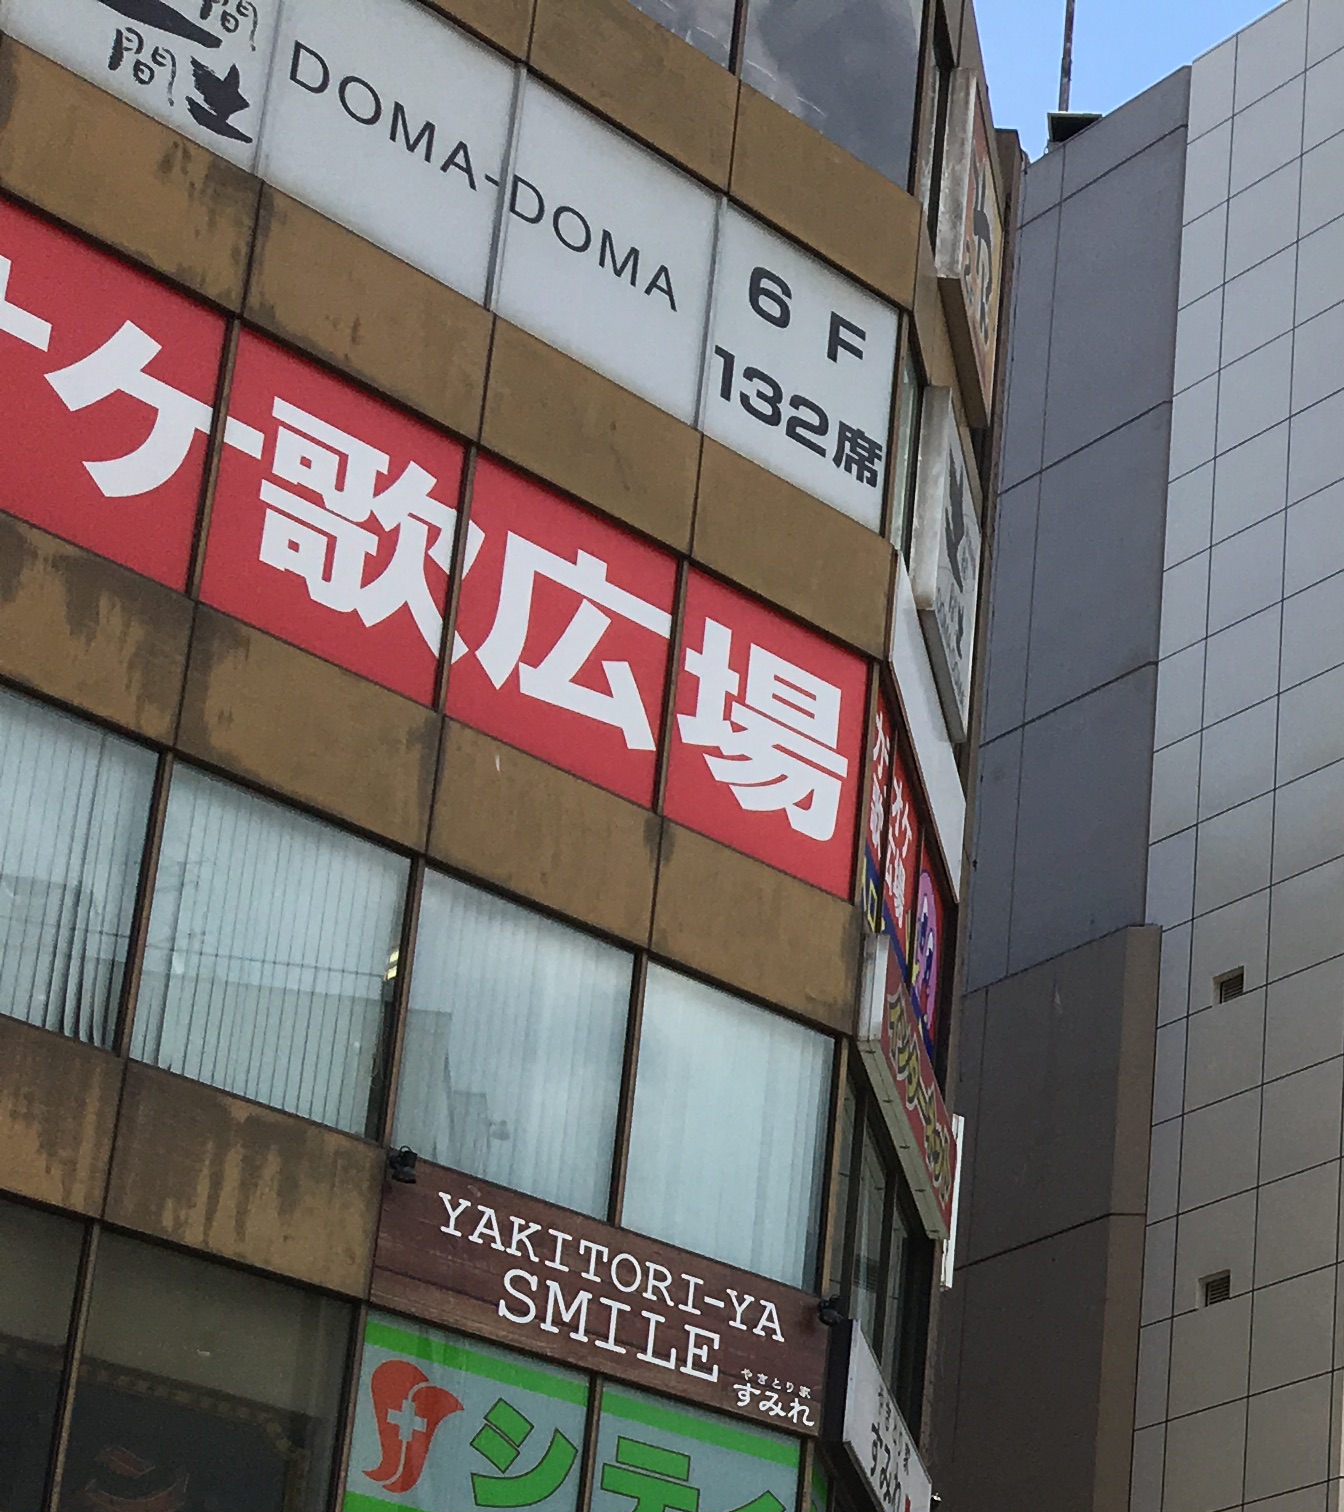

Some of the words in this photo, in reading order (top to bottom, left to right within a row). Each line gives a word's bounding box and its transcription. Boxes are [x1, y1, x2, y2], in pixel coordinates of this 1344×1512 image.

[288, 38, 680, 313] DOMA-DOMA
[713, 344, 884, 490] 132席
[437, 1192, 787, 1344] YAKITORI-YA
[498, 1266, 722, 1384] SMILE
[732, 1382, 815, 1427] すみれ
